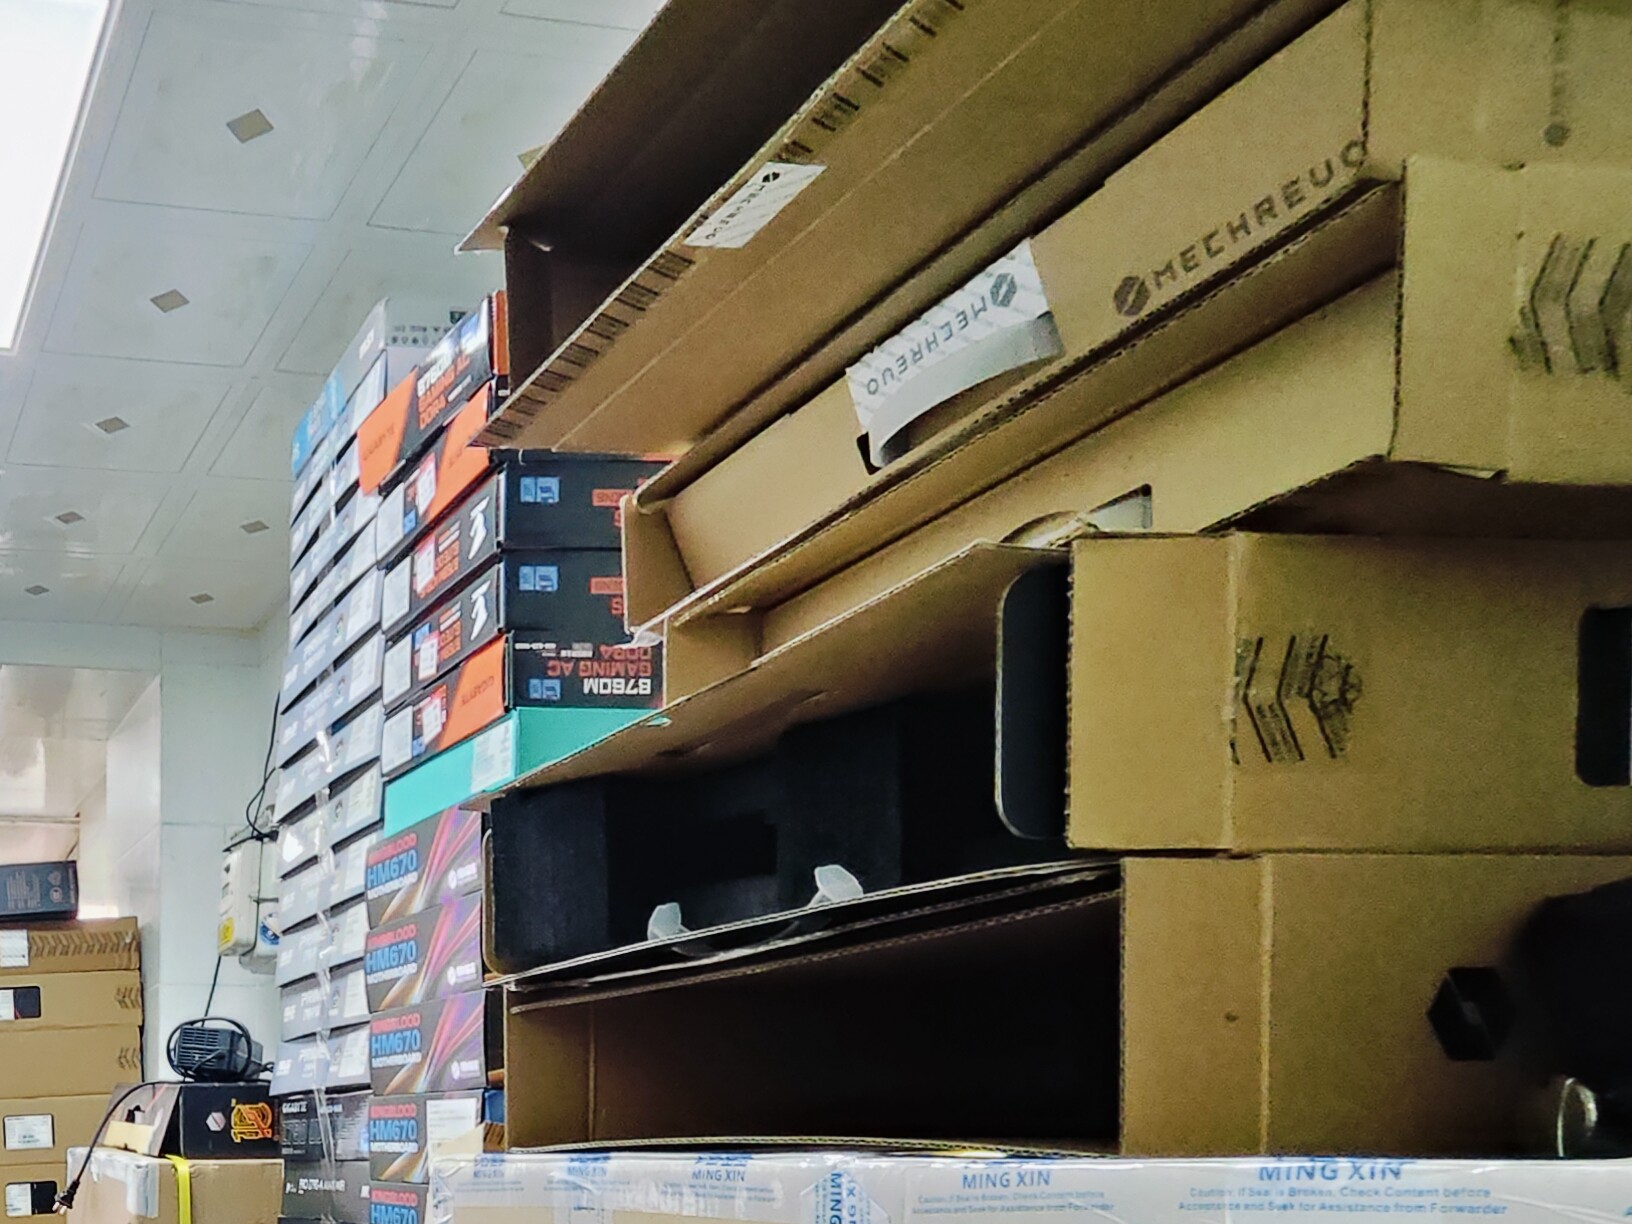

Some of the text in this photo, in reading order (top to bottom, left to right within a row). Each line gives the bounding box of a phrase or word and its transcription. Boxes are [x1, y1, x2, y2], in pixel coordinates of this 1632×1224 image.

[547, 660, 652, 677] GAMING AC
[583, 678, 651, 695] B760M
[366, 848, 418, 890] HM670
[365, 940, 417, 975] HM670
[371, 1028, 421, 1057] HM670
[369, 1119, 417, 1141] HM670
[691, 1169, 746, 1182] MING XIN
[962, 1171, 1051, 1189] MING XIN
[1259, 1162, 1402, 1181] MING XIN
